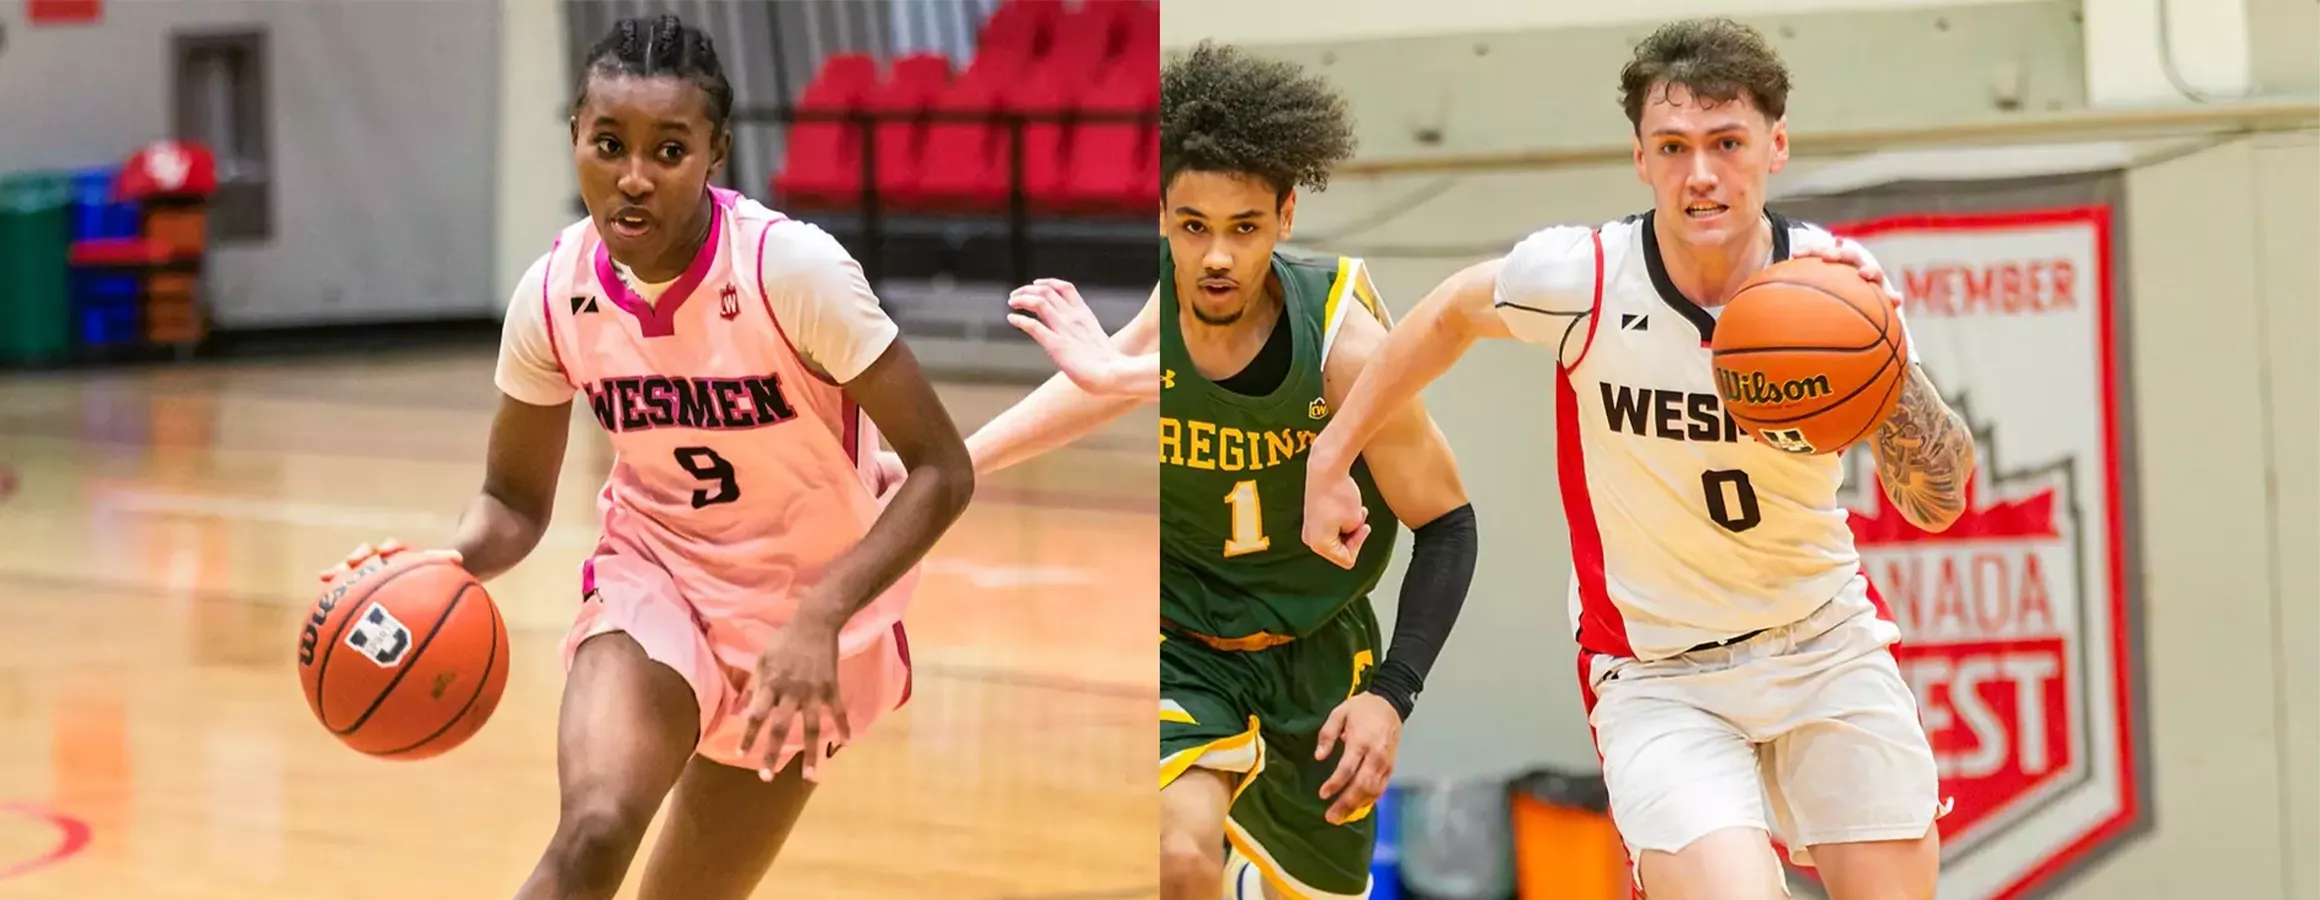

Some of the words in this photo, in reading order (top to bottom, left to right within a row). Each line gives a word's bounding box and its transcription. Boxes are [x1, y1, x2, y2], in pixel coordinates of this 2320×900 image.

[1904, 259, 2077, 317] MEMBER
[581, 373, 798, 433] WESMEN
[1717, 367, 1833, 404] Wilson
[674, 447, 740, 509] 9
[1701, 469, 1762, 533] 0
[1223, 480, 1270, 557] 1
[1906, 655, 2060, 778] EST
